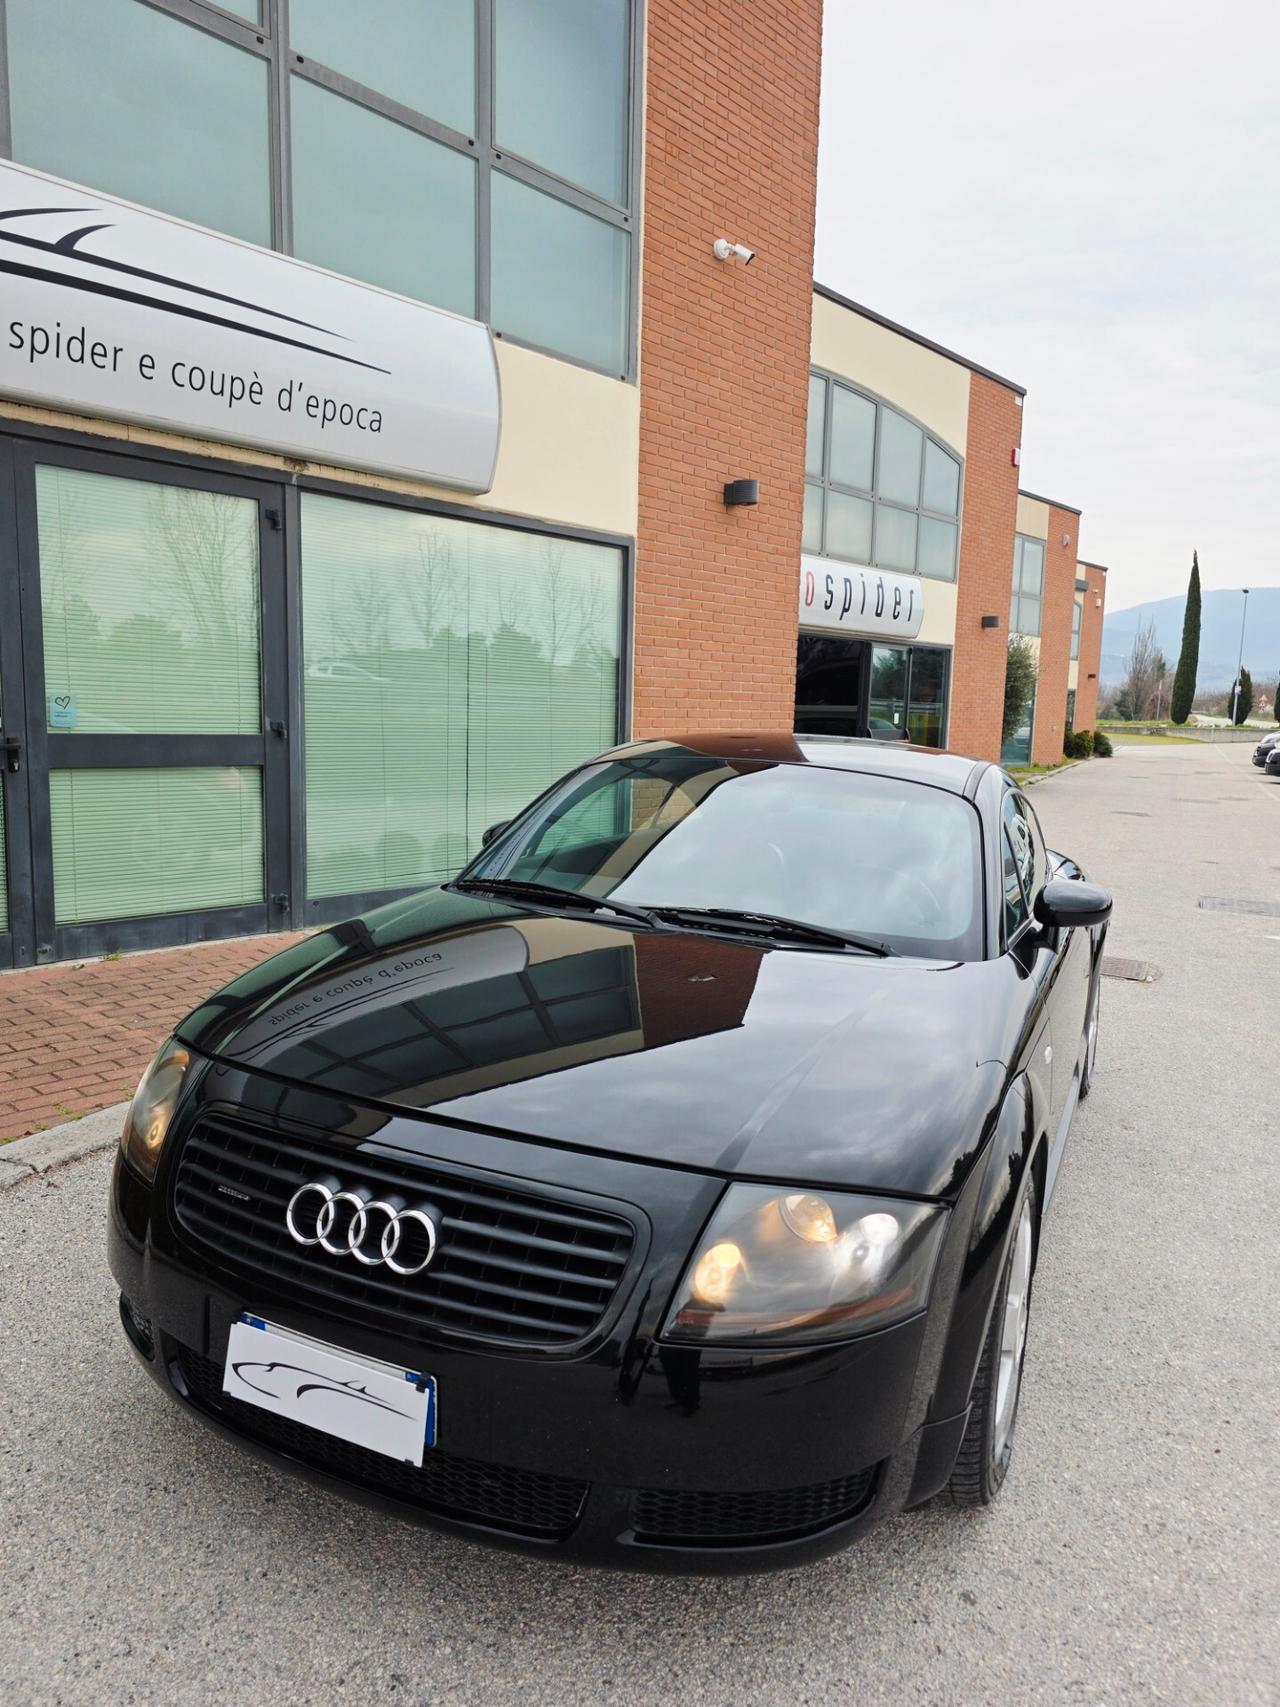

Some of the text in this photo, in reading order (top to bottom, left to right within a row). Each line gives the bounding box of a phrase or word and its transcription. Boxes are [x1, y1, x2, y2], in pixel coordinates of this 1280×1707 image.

[8, 319, 384, 433] spider e coupè d'epoca
